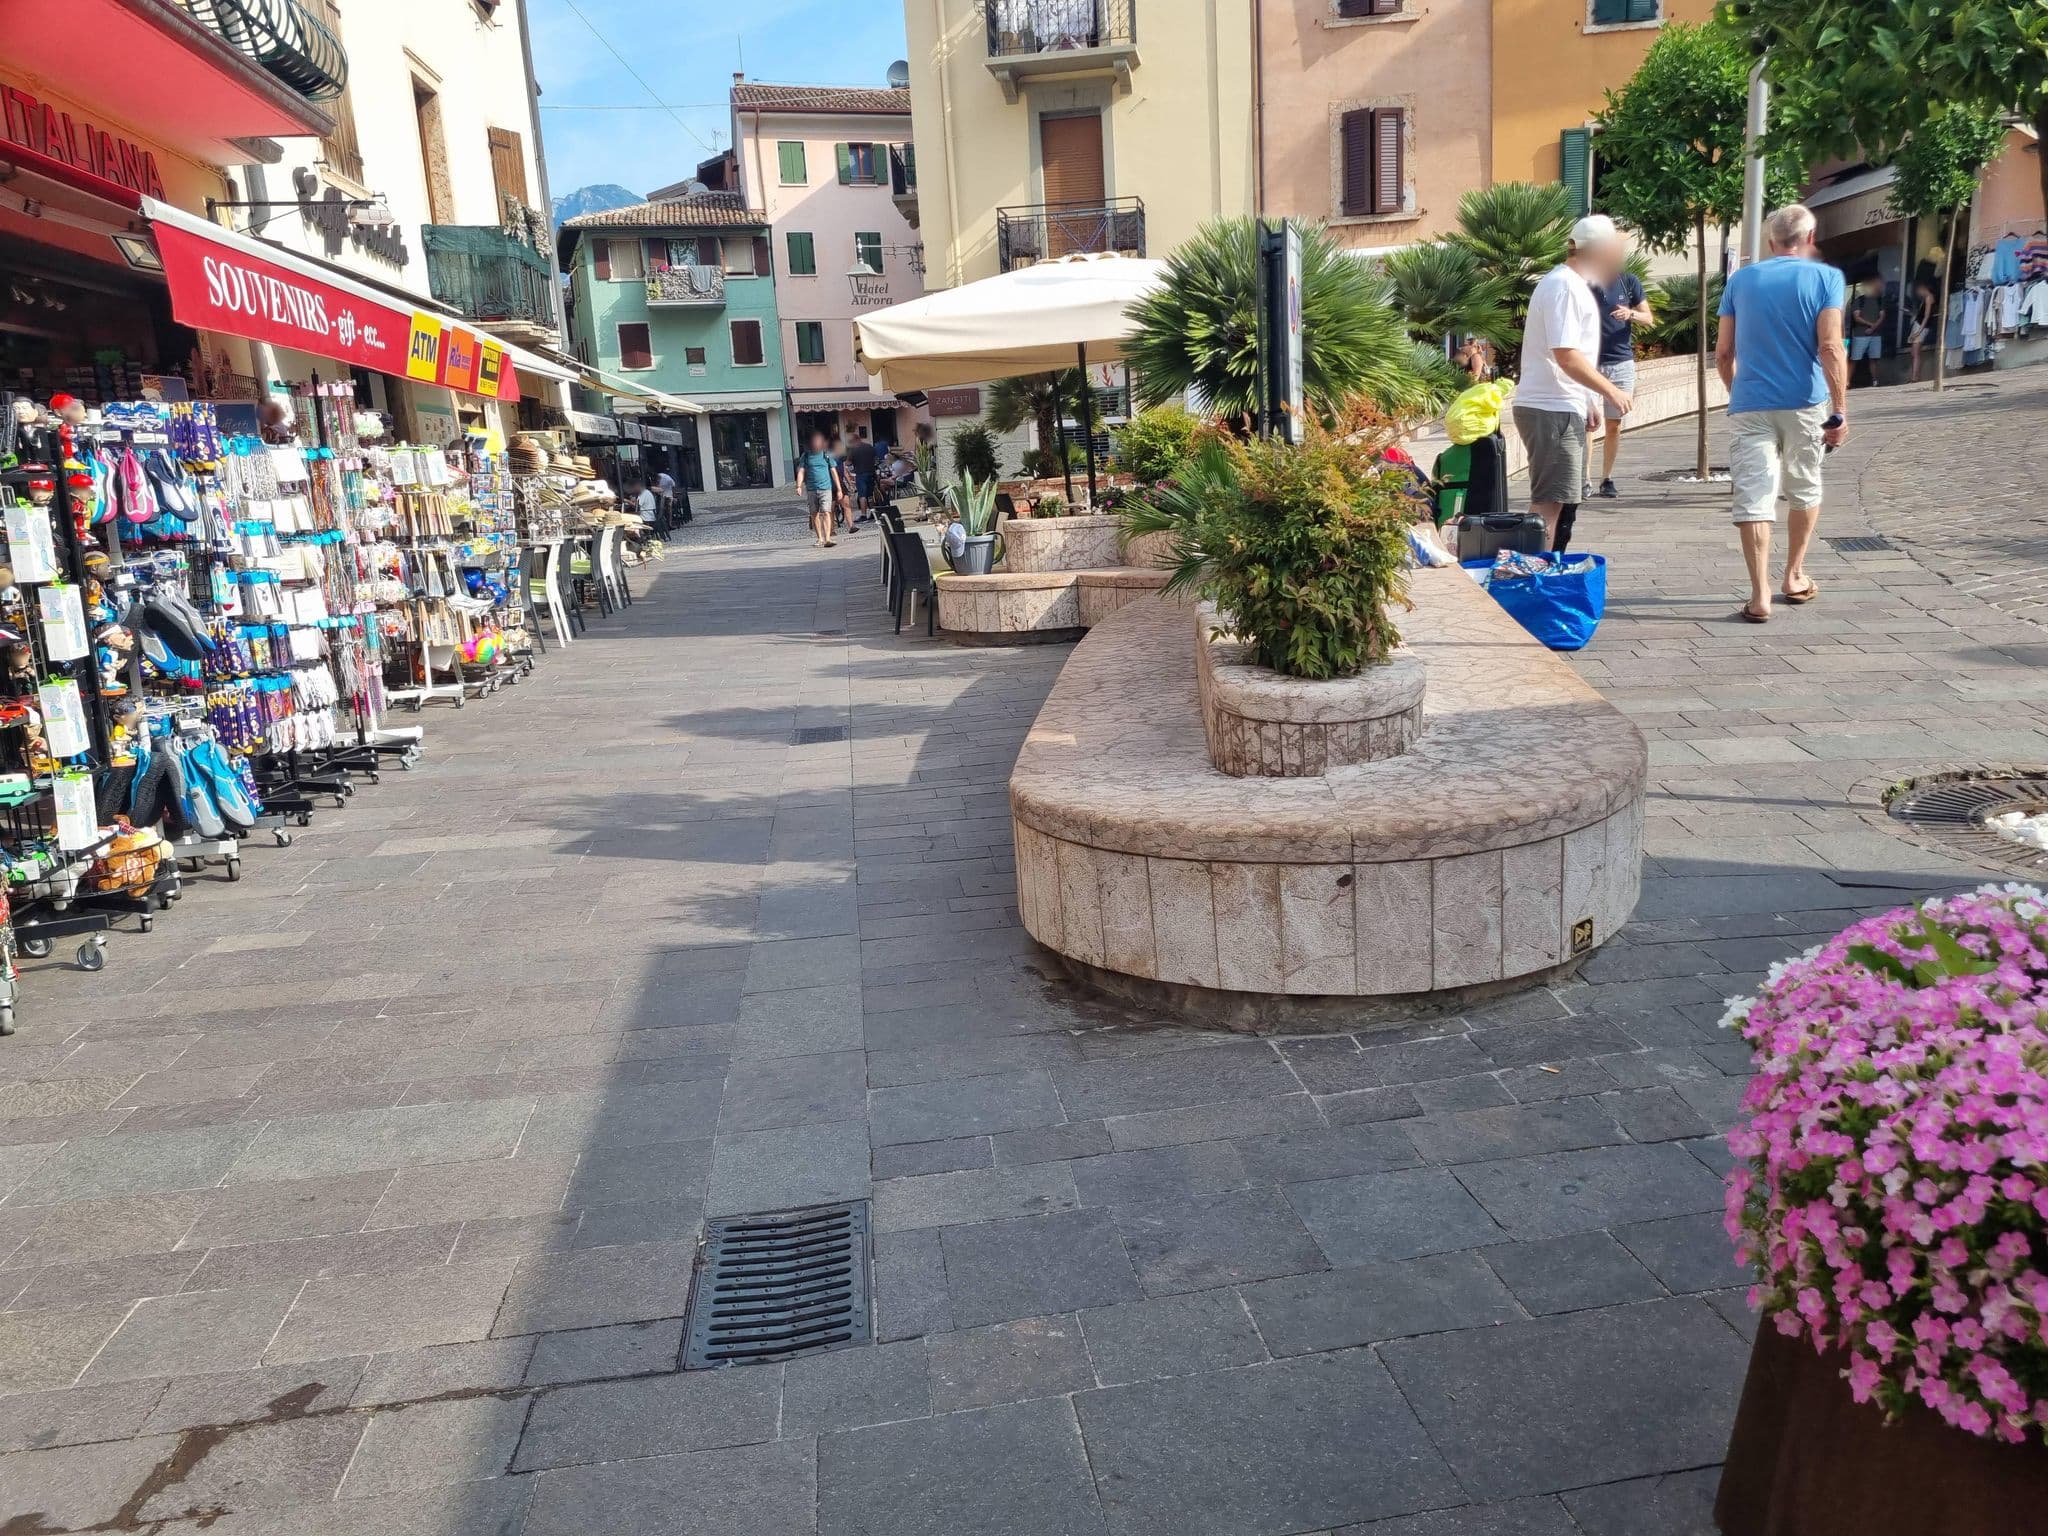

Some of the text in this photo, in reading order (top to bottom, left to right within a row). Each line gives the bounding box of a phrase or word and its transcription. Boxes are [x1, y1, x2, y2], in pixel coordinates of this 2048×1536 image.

[0, 84, 167, 203] ITALIANA
[851, 294, 894, 306] Aurora
[858, 283, 889, 295] Hotel
[202, 255, 330, 336] SOUVENIRS
[337, 307, 356, 347] gift
[411, 330, 438, 365] ATM
[935, 395, 971, 405] ZANETTI
